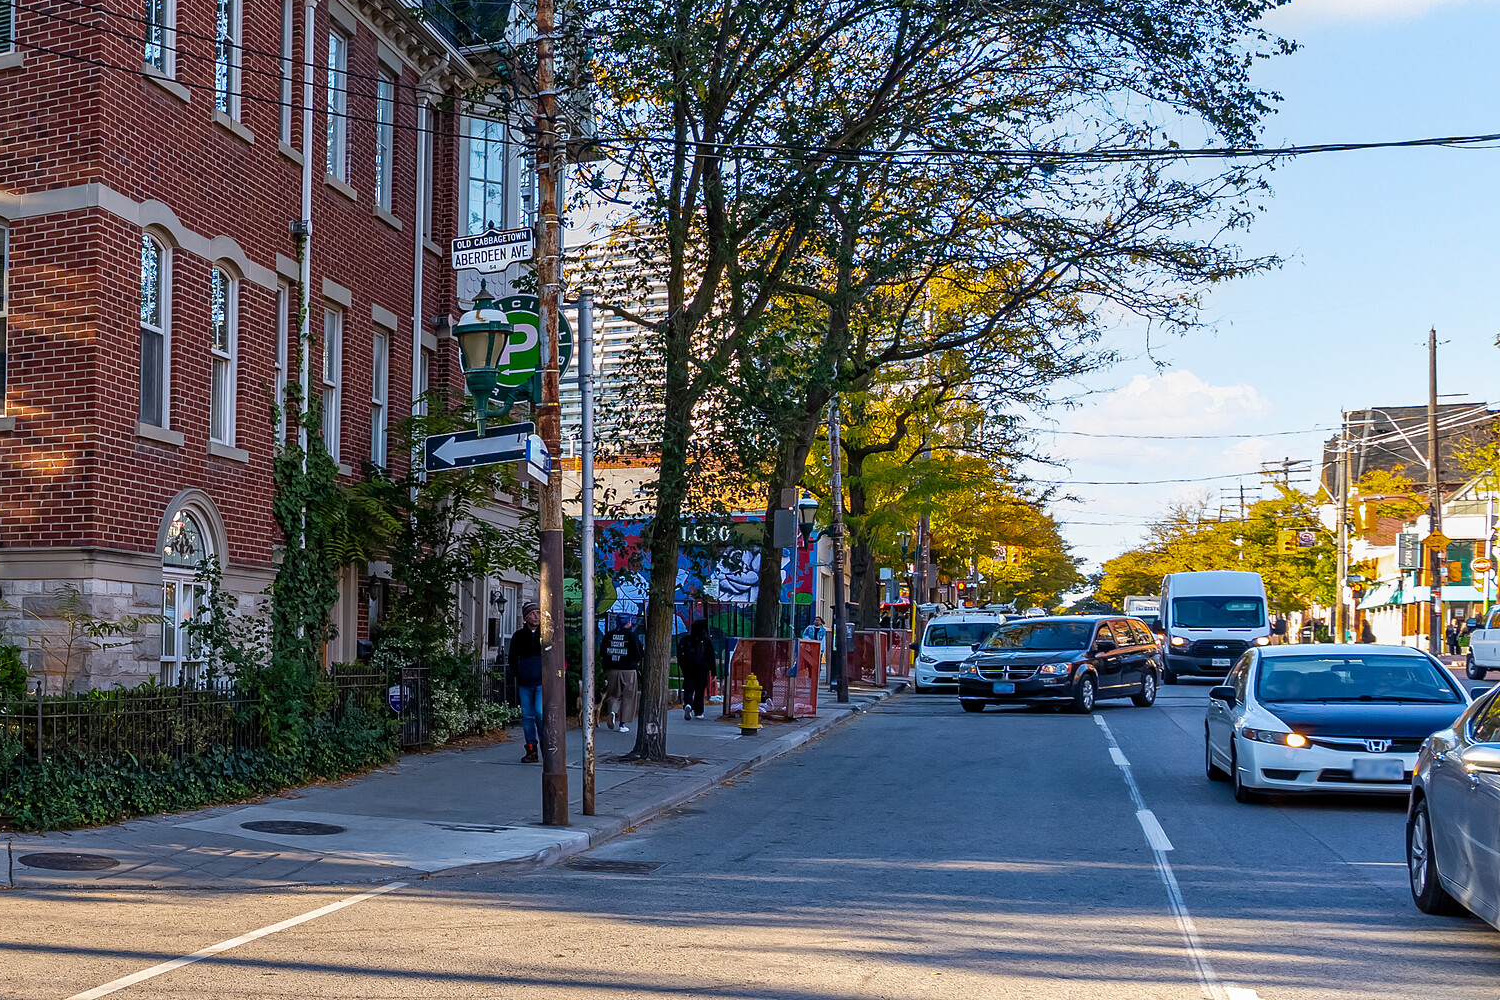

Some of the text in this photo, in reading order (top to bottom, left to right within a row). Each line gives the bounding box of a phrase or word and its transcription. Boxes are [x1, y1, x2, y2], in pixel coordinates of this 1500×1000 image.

[457, 231, 527, 249] OLD CABBAGETOWN
[455, 244, 531, 267] ABERDEEN AVE.
